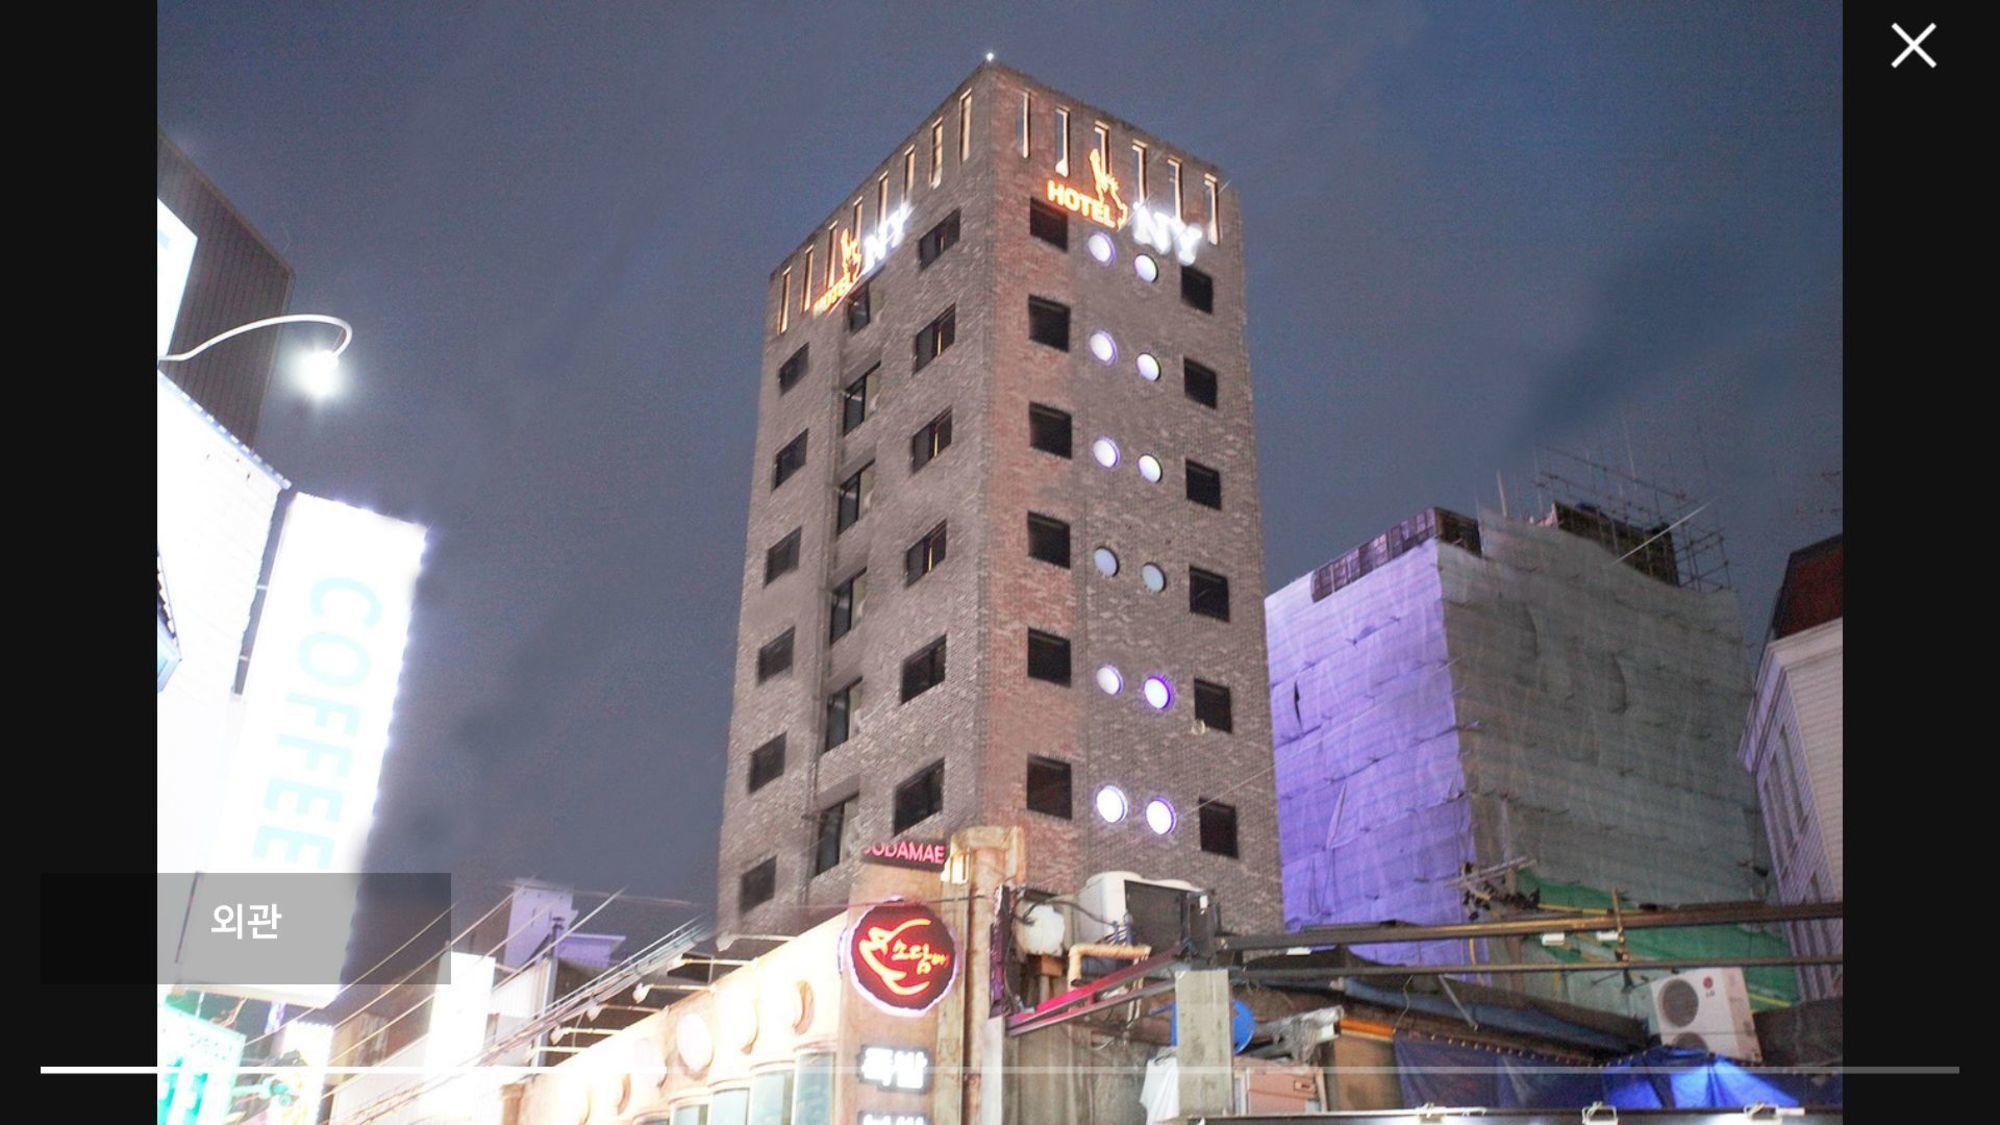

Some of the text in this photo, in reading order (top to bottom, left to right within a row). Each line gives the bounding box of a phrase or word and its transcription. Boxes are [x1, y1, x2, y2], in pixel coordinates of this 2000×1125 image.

[1047, 179, 1203, 265] HOTEL NY
[252, 577, 382, 870] COFFEE
